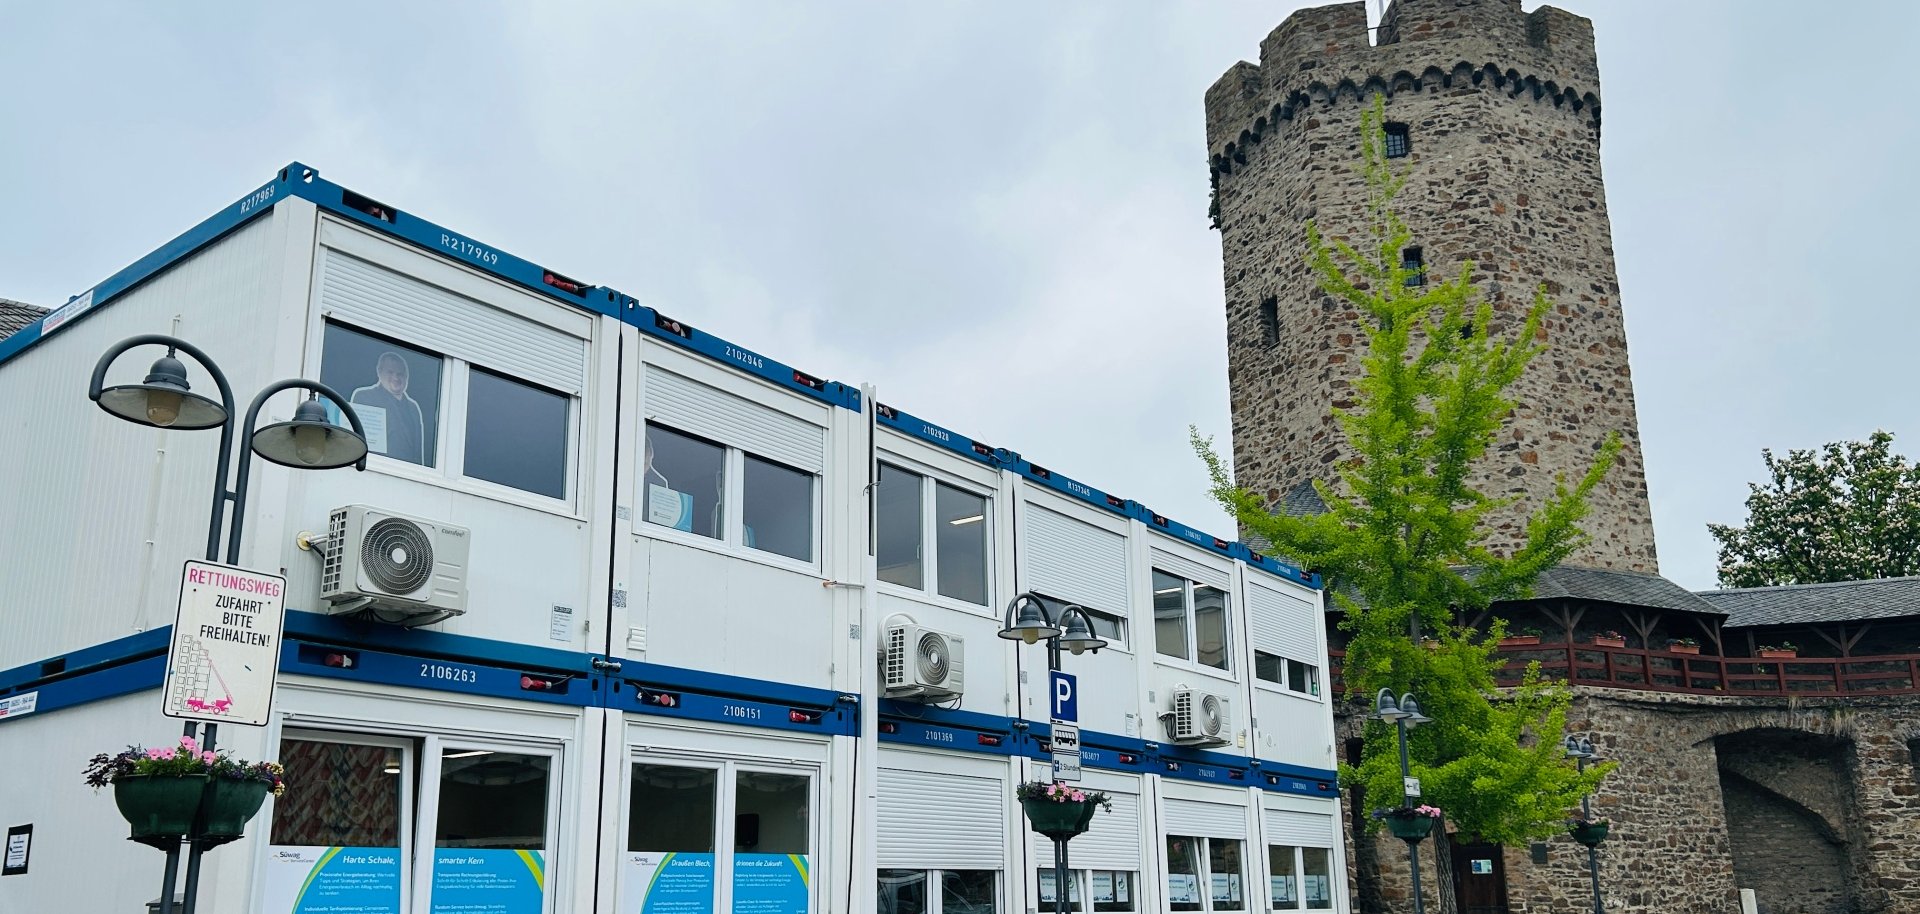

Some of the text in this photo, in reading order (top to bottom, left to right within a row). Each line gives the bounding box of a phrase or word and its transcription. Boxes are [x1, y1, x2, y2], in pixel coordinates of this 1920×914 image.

[240, 185, 274, 215] R217969
[441, 234, 498, 265] R217969
[726, 346, 763, 368] 2102946
[189, 568, 280, 597] RETTUNGSWEG
[216, 594, 264, 614] ZUFAHRT
[222, 612, 253, 628] BITTE
[200, 624, 270, 647] FREIHALTEN!
[420, 664, 476, 683] 2106263
[1056, 678, 1072, 714] P
[724, 705, 760, 720] 2106151
[926, 730, 952, 742] 2101369
[343, 856, 396, 865] Harte Schale,
[695, 860, 711, 868] Blech,
